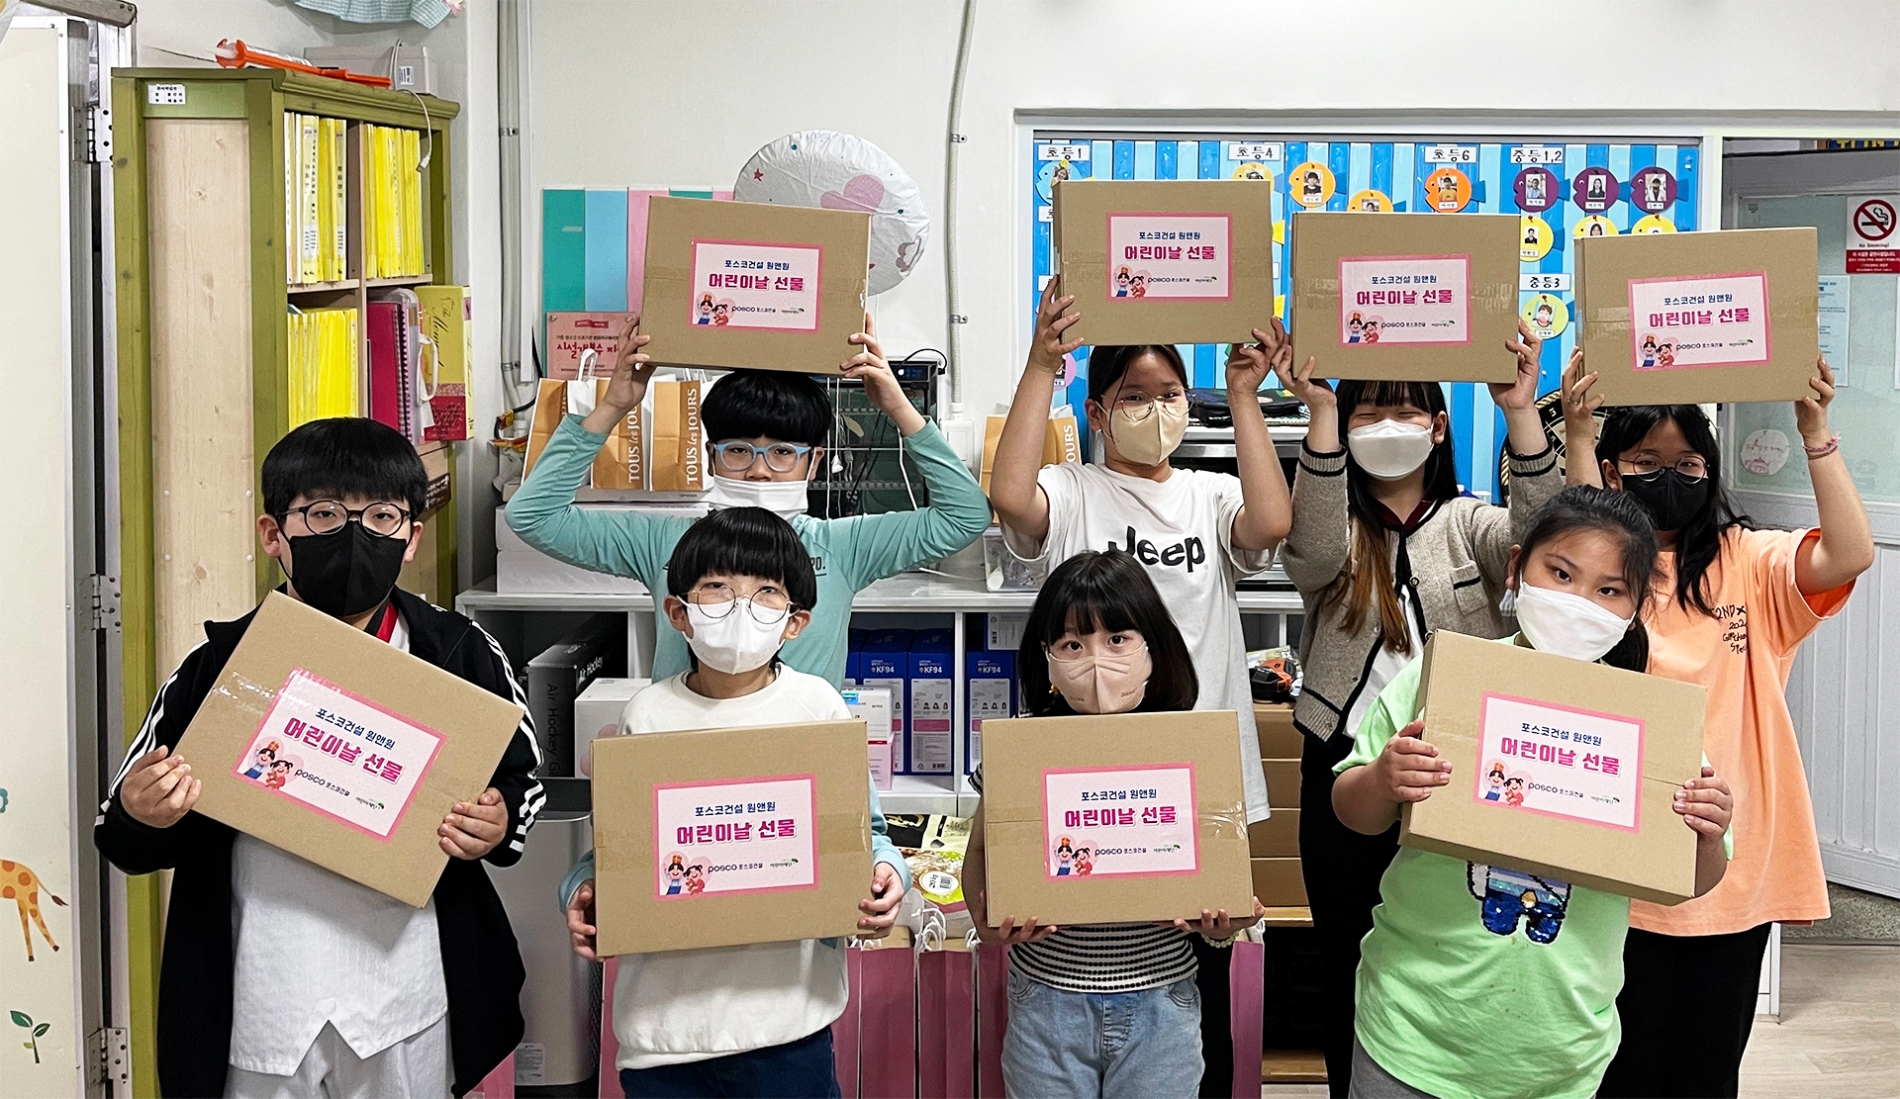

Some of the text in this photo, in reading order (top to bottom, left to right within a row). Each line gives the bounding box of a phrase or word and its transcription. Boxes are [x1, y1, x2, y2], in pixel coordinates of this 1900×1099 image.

[1046, 146, 1082, 160] 초등1
[1236, 146, 1273, 160] 초등4
[1432, 149, 1470, 162] 초등6
[1512, 149, 1562, 163] 중등1,2
[1139, 232, 1201, 240] 포스코건설 원앤원
[1124, 246, 1215, 260] 어린이날 선물
[724, 260, 790, 271] 포스코건설 원앤원
[708, 273, 804, 291] 어린이날 선물
[1371, 275, 1437, 284] 포스코건설 원앤원
[1529, 276, 1560, 289] 중등3
[1356, 289, 1453, 305] 어린이날 선물
[1664, 294, 1733, 305] 포스코건설 원앤원
[1649, 307, 1750, 328] 어린이날 선물
[687, 388, 699, 431] JOURS
[628, 430, 638, 444] les
[687, 432, 698, 445] les
[1063, 424, 1076, 463] OURS
[628, 446, 640, 483] TOUS
[686, 446, 698, 485] TOUS
[547, 683, 558, 699] Air
[315, 708, 396, 749] 포스코건설 원앤원
[545, 708, 559, 755] Hockey
[1521, 723, 1602, 747] 포스코건설 원앤원
[283, 717, 403, 783] 어린이날 선물
[1501, 737, 1620, 775] 어린이날 선물
[326, 781, 350, 797] 포스코건설
[1081, 788, 1157, 801] 포스코건설 원앤원
[695, 801, 776, 817] 포스코건설 원앤원
[1065, 806, 1177, 828] 어린이날 선물
[676, 818, 795, 845] 어린이날 선물
[738, 863, 763, 871] 포스코건설
